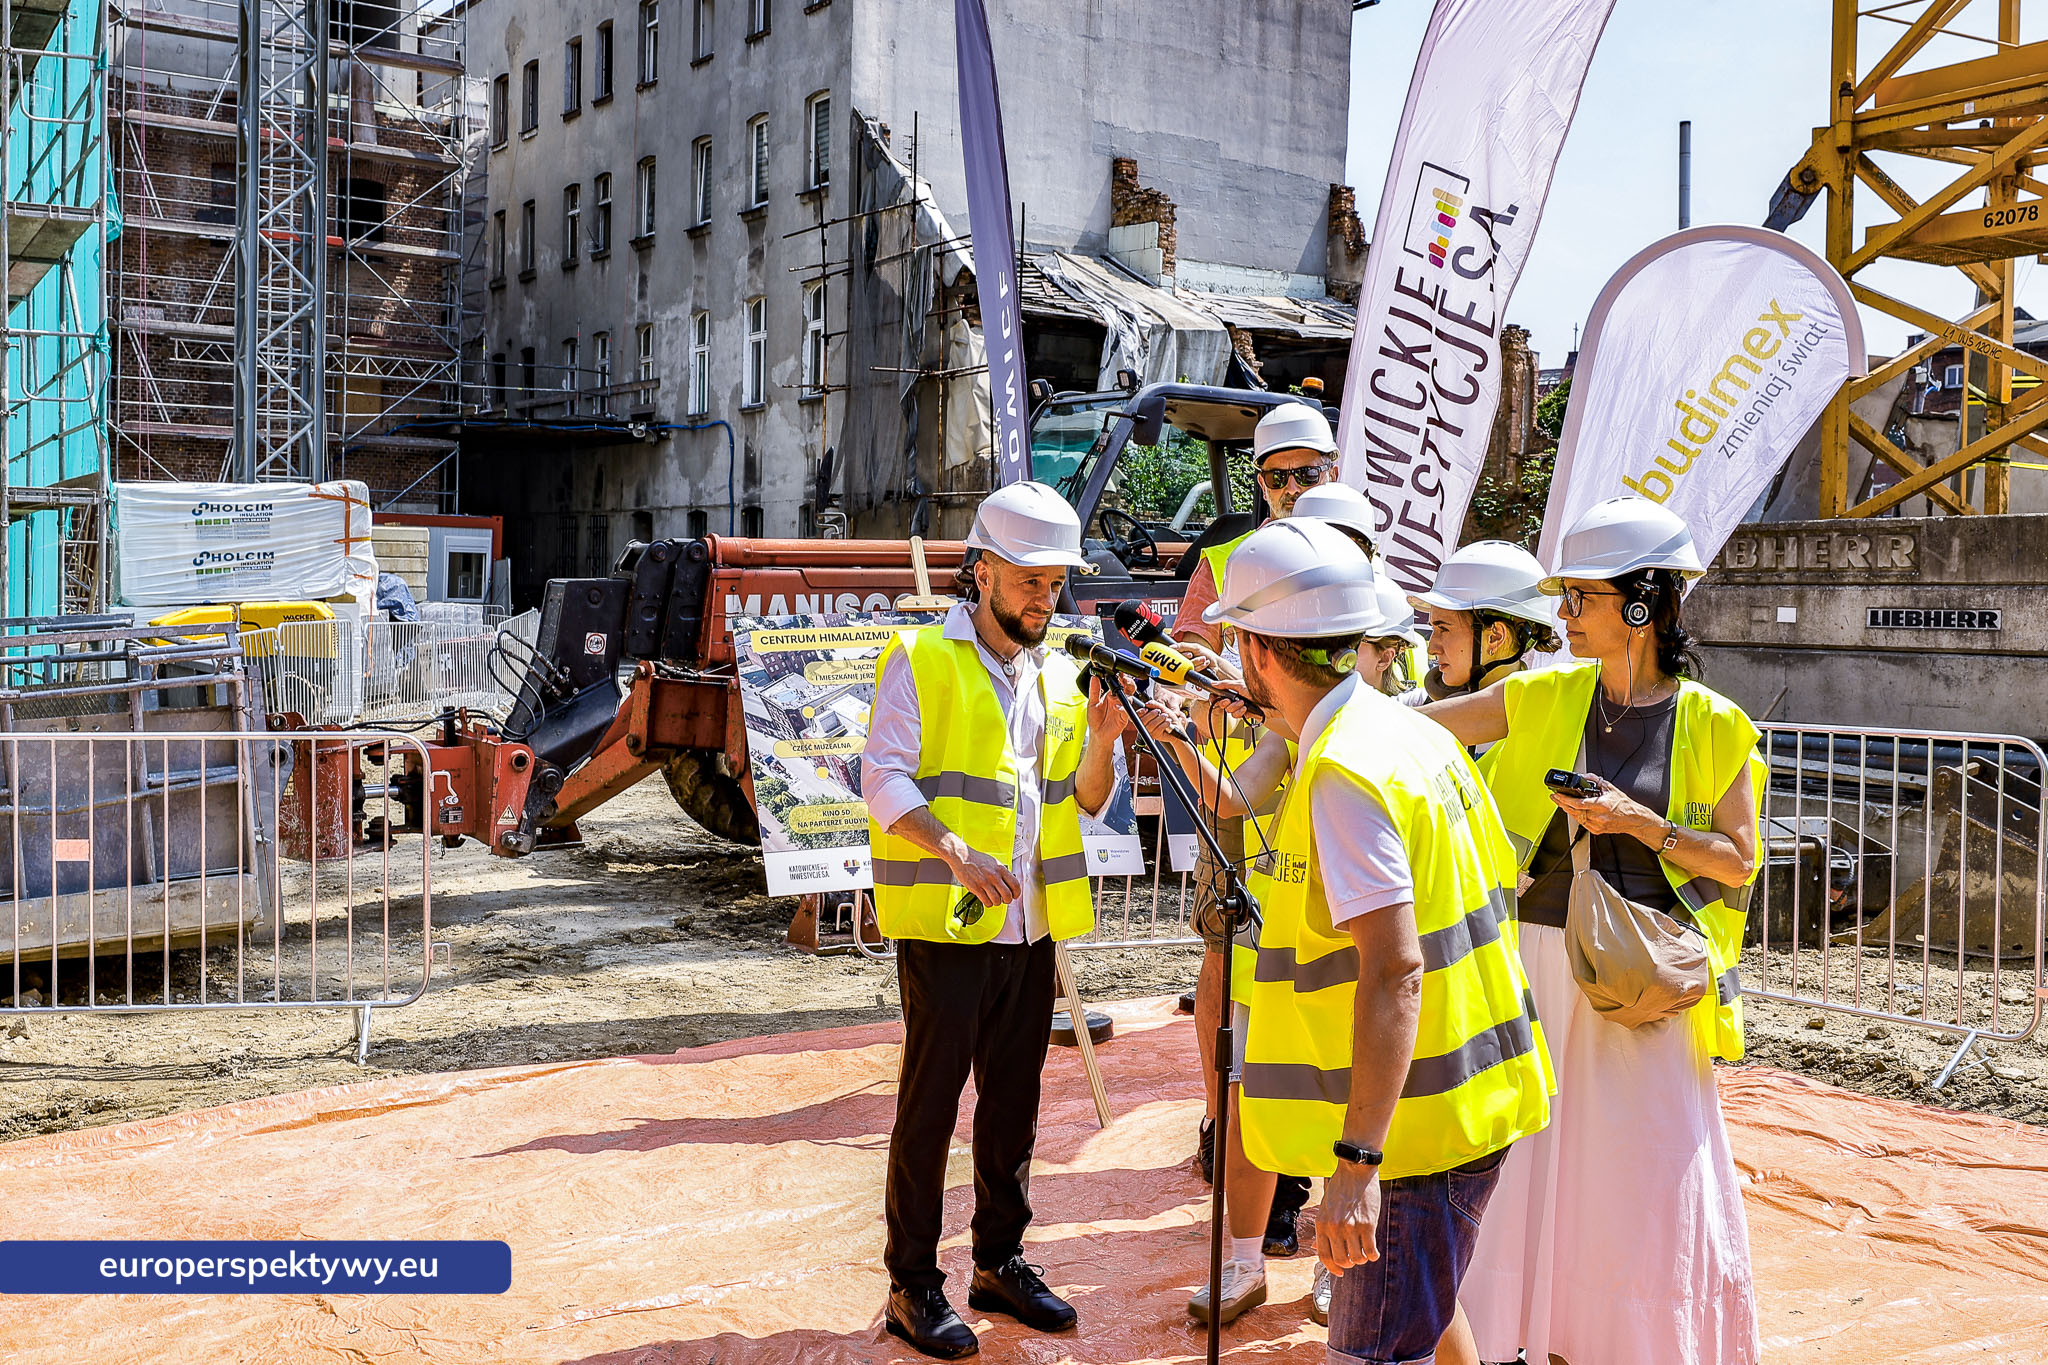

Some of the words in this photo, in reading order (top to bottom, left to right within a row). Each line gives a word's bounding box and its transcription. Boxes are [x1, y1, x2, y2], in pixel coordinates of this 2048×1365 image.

[1983, 205, 2039, 228] 62078
[1718, 373, 1792, 459] zmieniaj
[1777, 322, 1828, 377] świat
[1622, 298, 1803, 504] budimex
[210, 503, 273, 513] HOLCIM
[211, 551, 275, 562] HOLCIM
[1869, 609, 1998, 629] LIEBHERR
[760, 634, 816, 646] CENTRUM
[819, 631, 890, 643] HIMALAIZMU
[1143, 650, 1182, 673] RMF
[792, 743, 813, 752] CZĘŚĆ
[813, 742, 852, 751] MUZEALNA
[822, 809, 840, 817] KINO
[809, 819, 842, 828] PARTERZE
[844, 817, 868, 825] BUDYN
